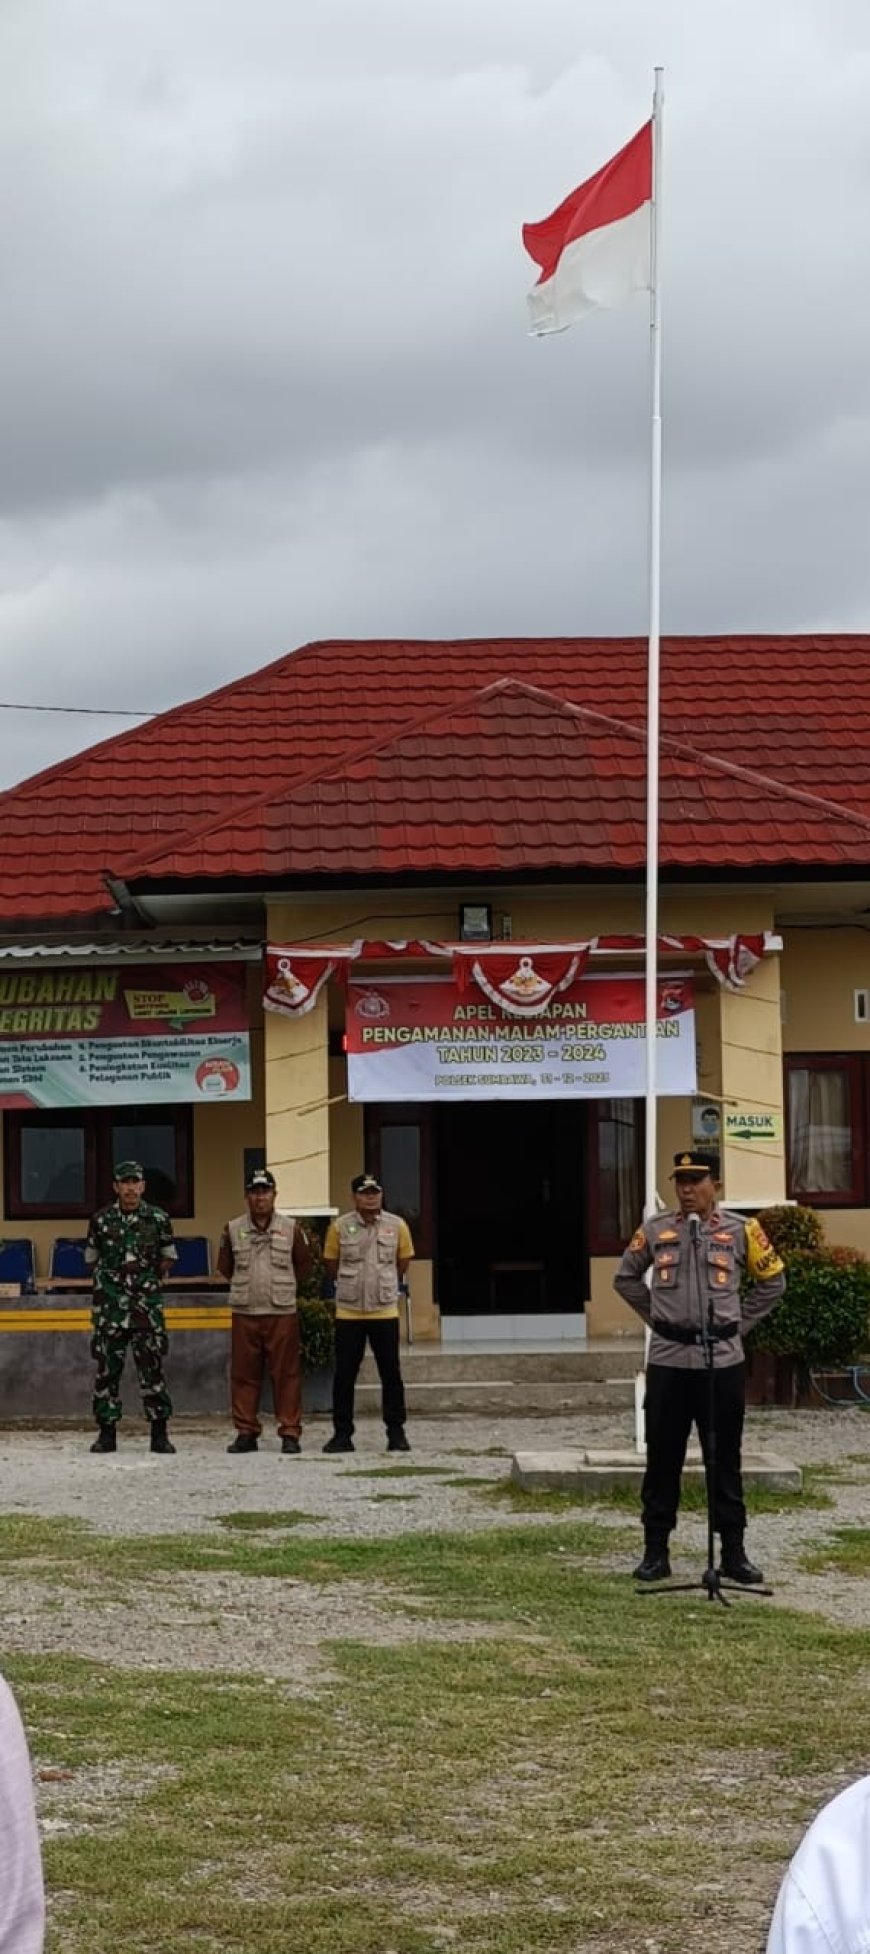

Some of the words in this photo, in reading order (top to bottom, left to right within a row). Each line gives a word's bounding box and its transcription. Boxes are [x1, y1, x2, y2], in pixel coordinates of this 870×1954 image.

[453, 1004, 498, 1021] APEL
[361, 1025, 491, 1044] PENGAMANAN
[494, 1023, 562, 1043] MALAM
[565, 1020, 681, 1041] PERGANTAN
[20, 1042, 72, 1053] Perubahan
[88, 1041, 139, 1051] Penguatan
[89, 1052, 139, 1063] Penguatan
[141, 1050, 201, 1061] Pengawasan
[437, 1045, 498, 1065] TAHUN
[500, 1044, 545, 1064] 2023
[561, 1043, 607, 1063] 2024
[89, 1063, 149, 1074] Peningkatan
[89, 1073, 139, 1084] Pelayanan
[140, 1071, 171, 1081] Publik
[435, 1073, 477, 1087] POLSEK
[726, 1115, 774, 1127] MASUK
